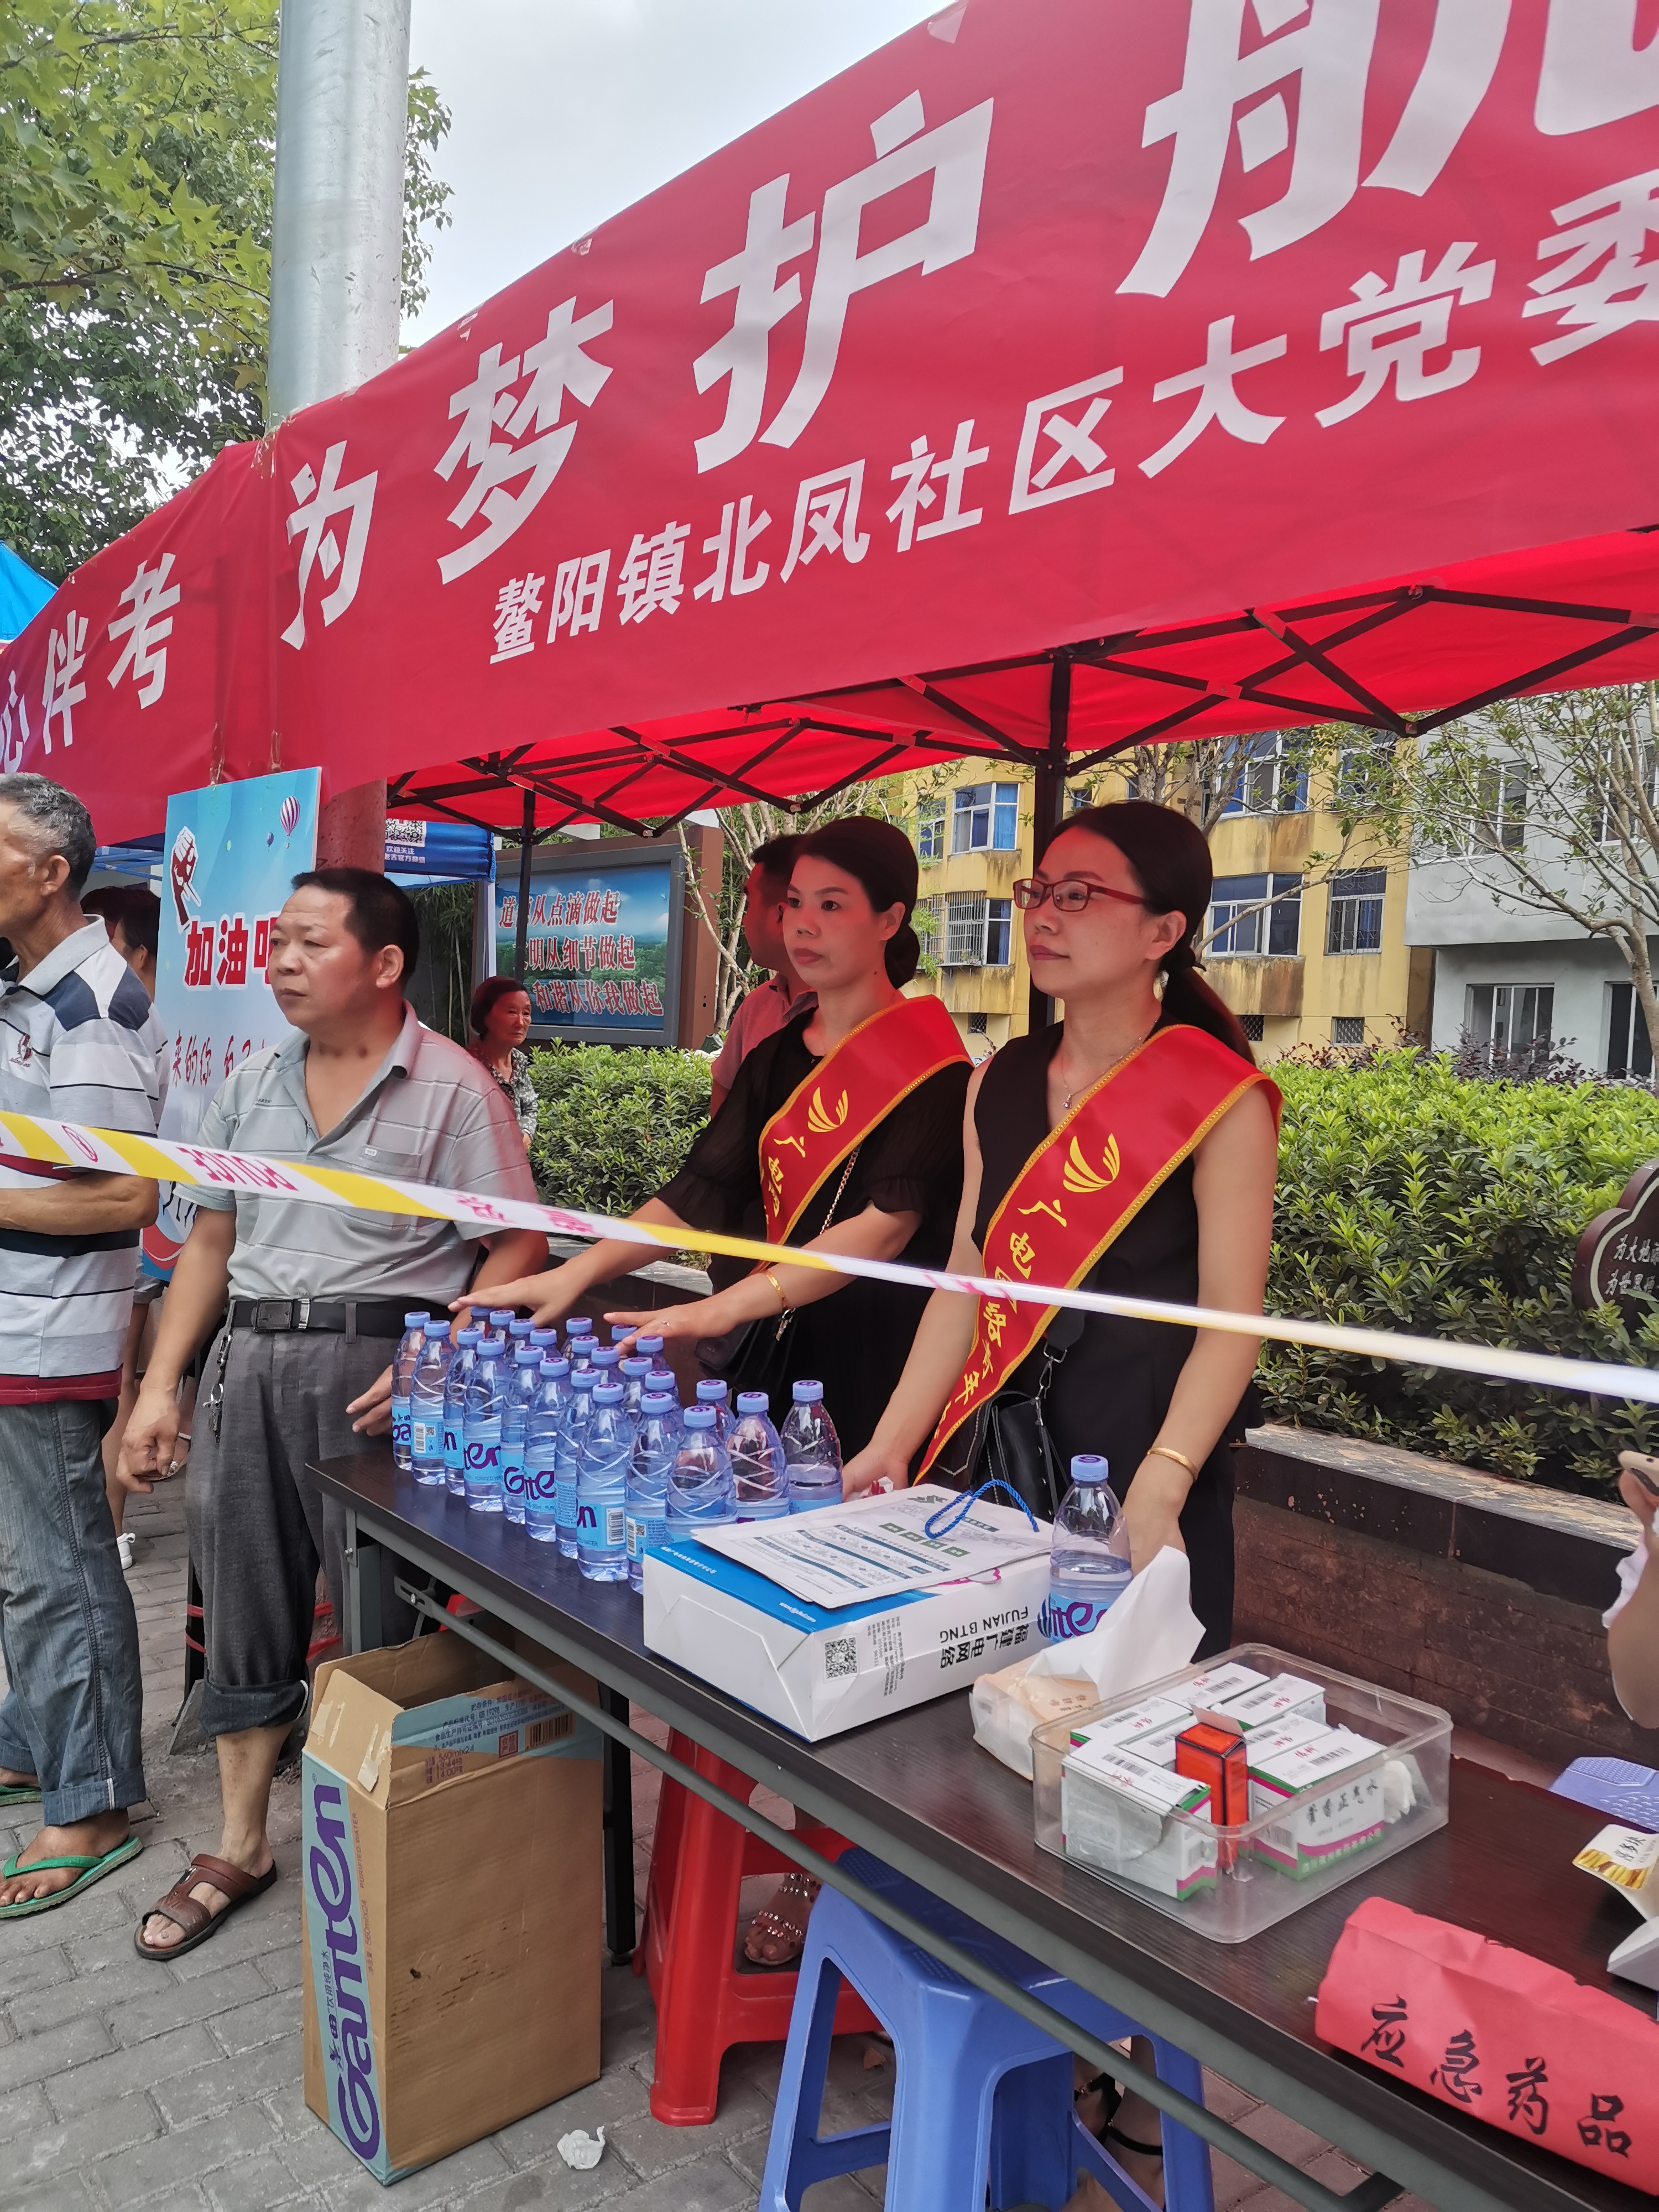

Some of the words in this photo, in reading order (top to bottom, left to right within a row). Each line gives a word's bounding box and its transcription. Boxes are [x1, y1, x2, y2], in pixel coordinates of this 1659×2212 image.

[490, 169, 1659, 665] 鳌阳镇北凤社区大党委
[386, 845, 415, 855] 欢迎关注
[513, 934, 636, 971] 明从细节做起
[533, 980, 664, 1016] 和谐从你我做起
[176, 1146, 299, 1192] POLICE
[940, 1621, 978, 1644] BTNG
[983, 1605, 1029, 1631] FUJIAN
[940, 1623, 1030, 1669] 福建广电网络
[310, 1784, 380, 2160] Ganten
[320, 1950, 335, 2008] 饮用纯净水
[1360, 1995, 1633, 2158] 应急药品
